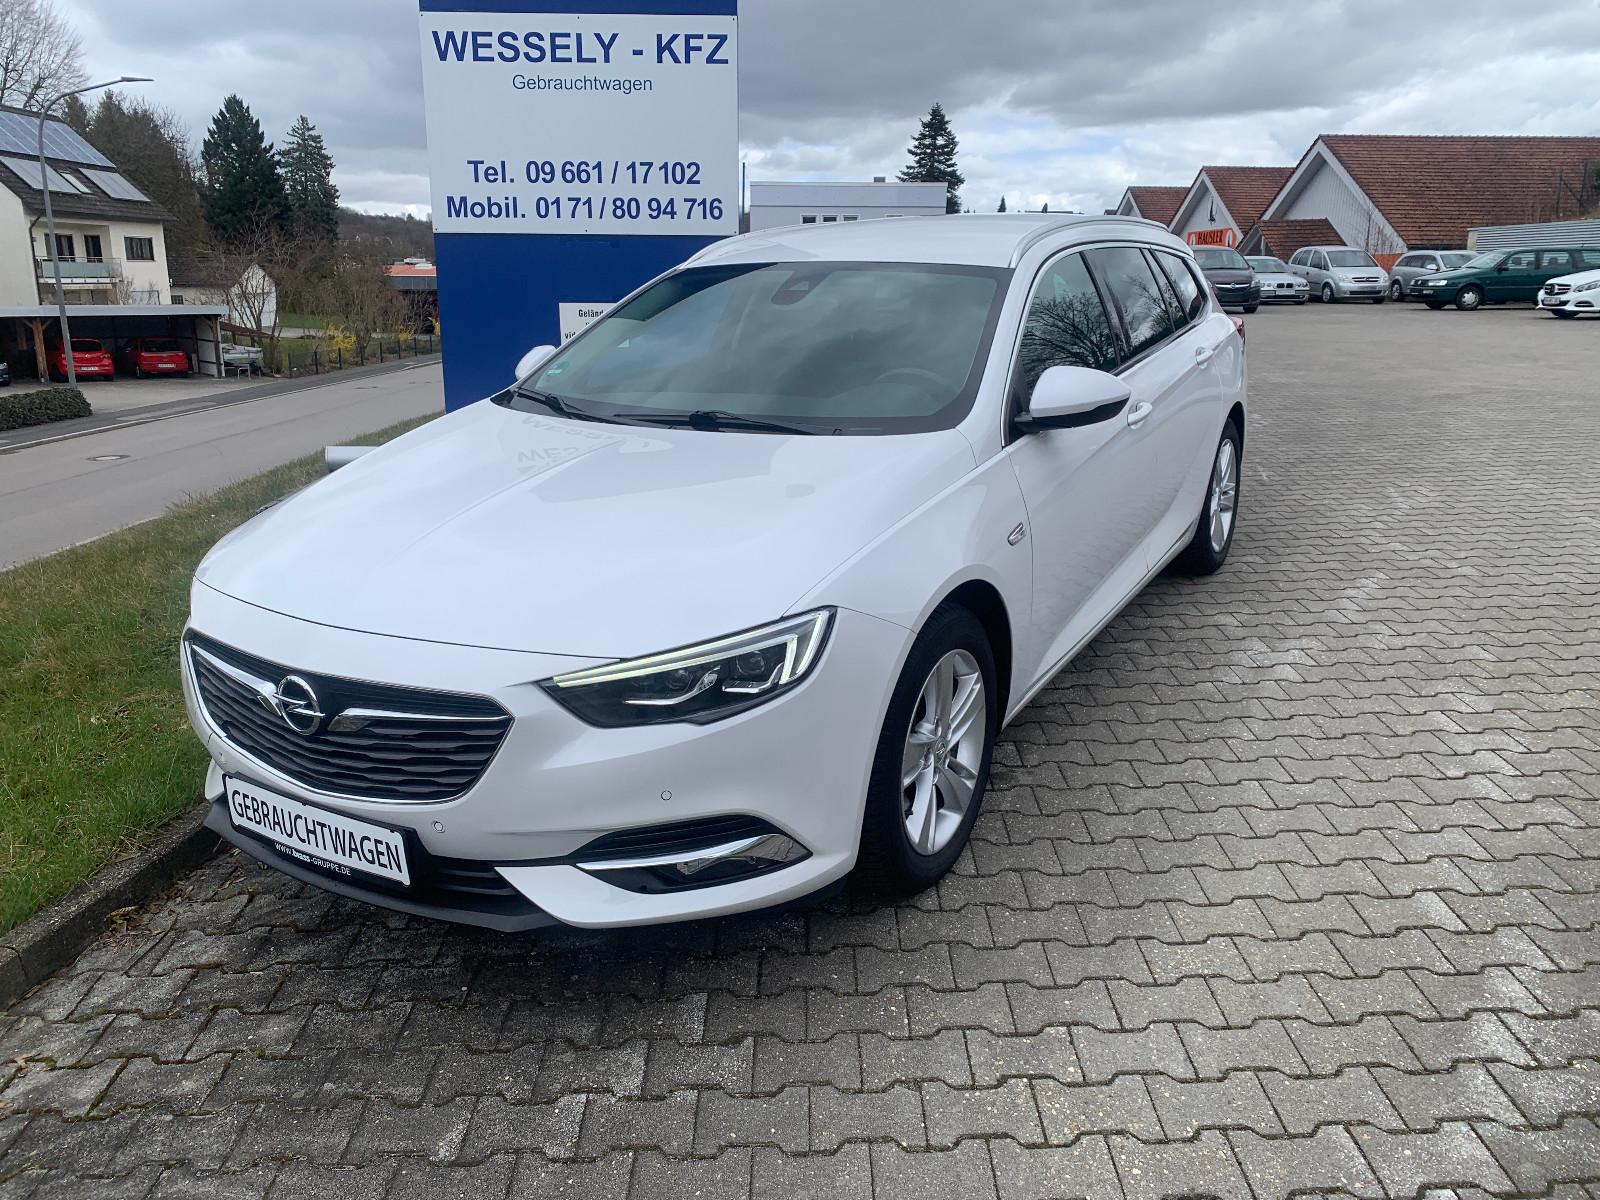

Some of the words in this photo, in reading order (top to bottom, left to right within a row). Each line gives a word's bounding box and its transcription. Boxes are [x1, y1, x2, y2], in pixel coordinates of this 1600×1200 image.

[432, 31, 619, 63] WESSELY
[656, 33, 729, 64] KFZ
[512, 74, 653, 94] Gebrauchtwagen
[467, 160, 515, 183] Tel.
[447, 196, 526, 219] Mobil.
[231, 789, 404, 874] GEBRAUCHTWAGEN
